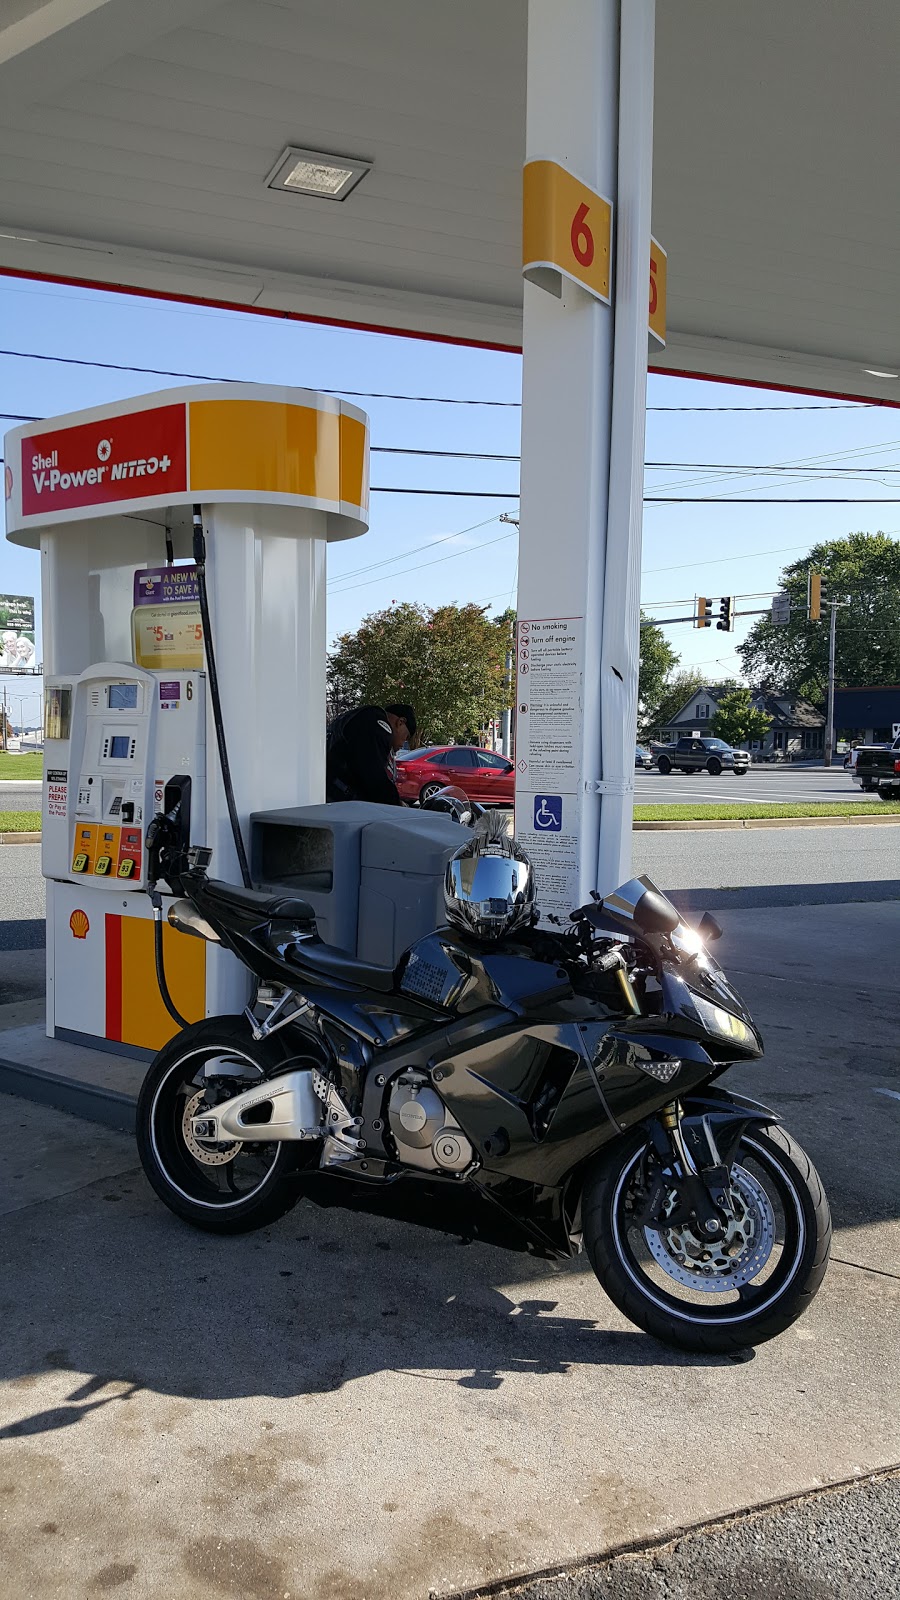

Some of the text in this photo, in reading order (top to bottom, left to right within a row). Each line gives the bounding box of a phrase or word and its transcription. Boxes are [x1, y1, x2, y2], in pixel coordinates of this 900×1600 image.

[571, 202, 594, 267] 6
[32, 450, 58, 471] Shell
[164, 572, 198, 583] A NEW W
[163, 586, 173, 595] TO
[175, 585, 192, 595] SAVE
[187, 680, 192, 700] 6
